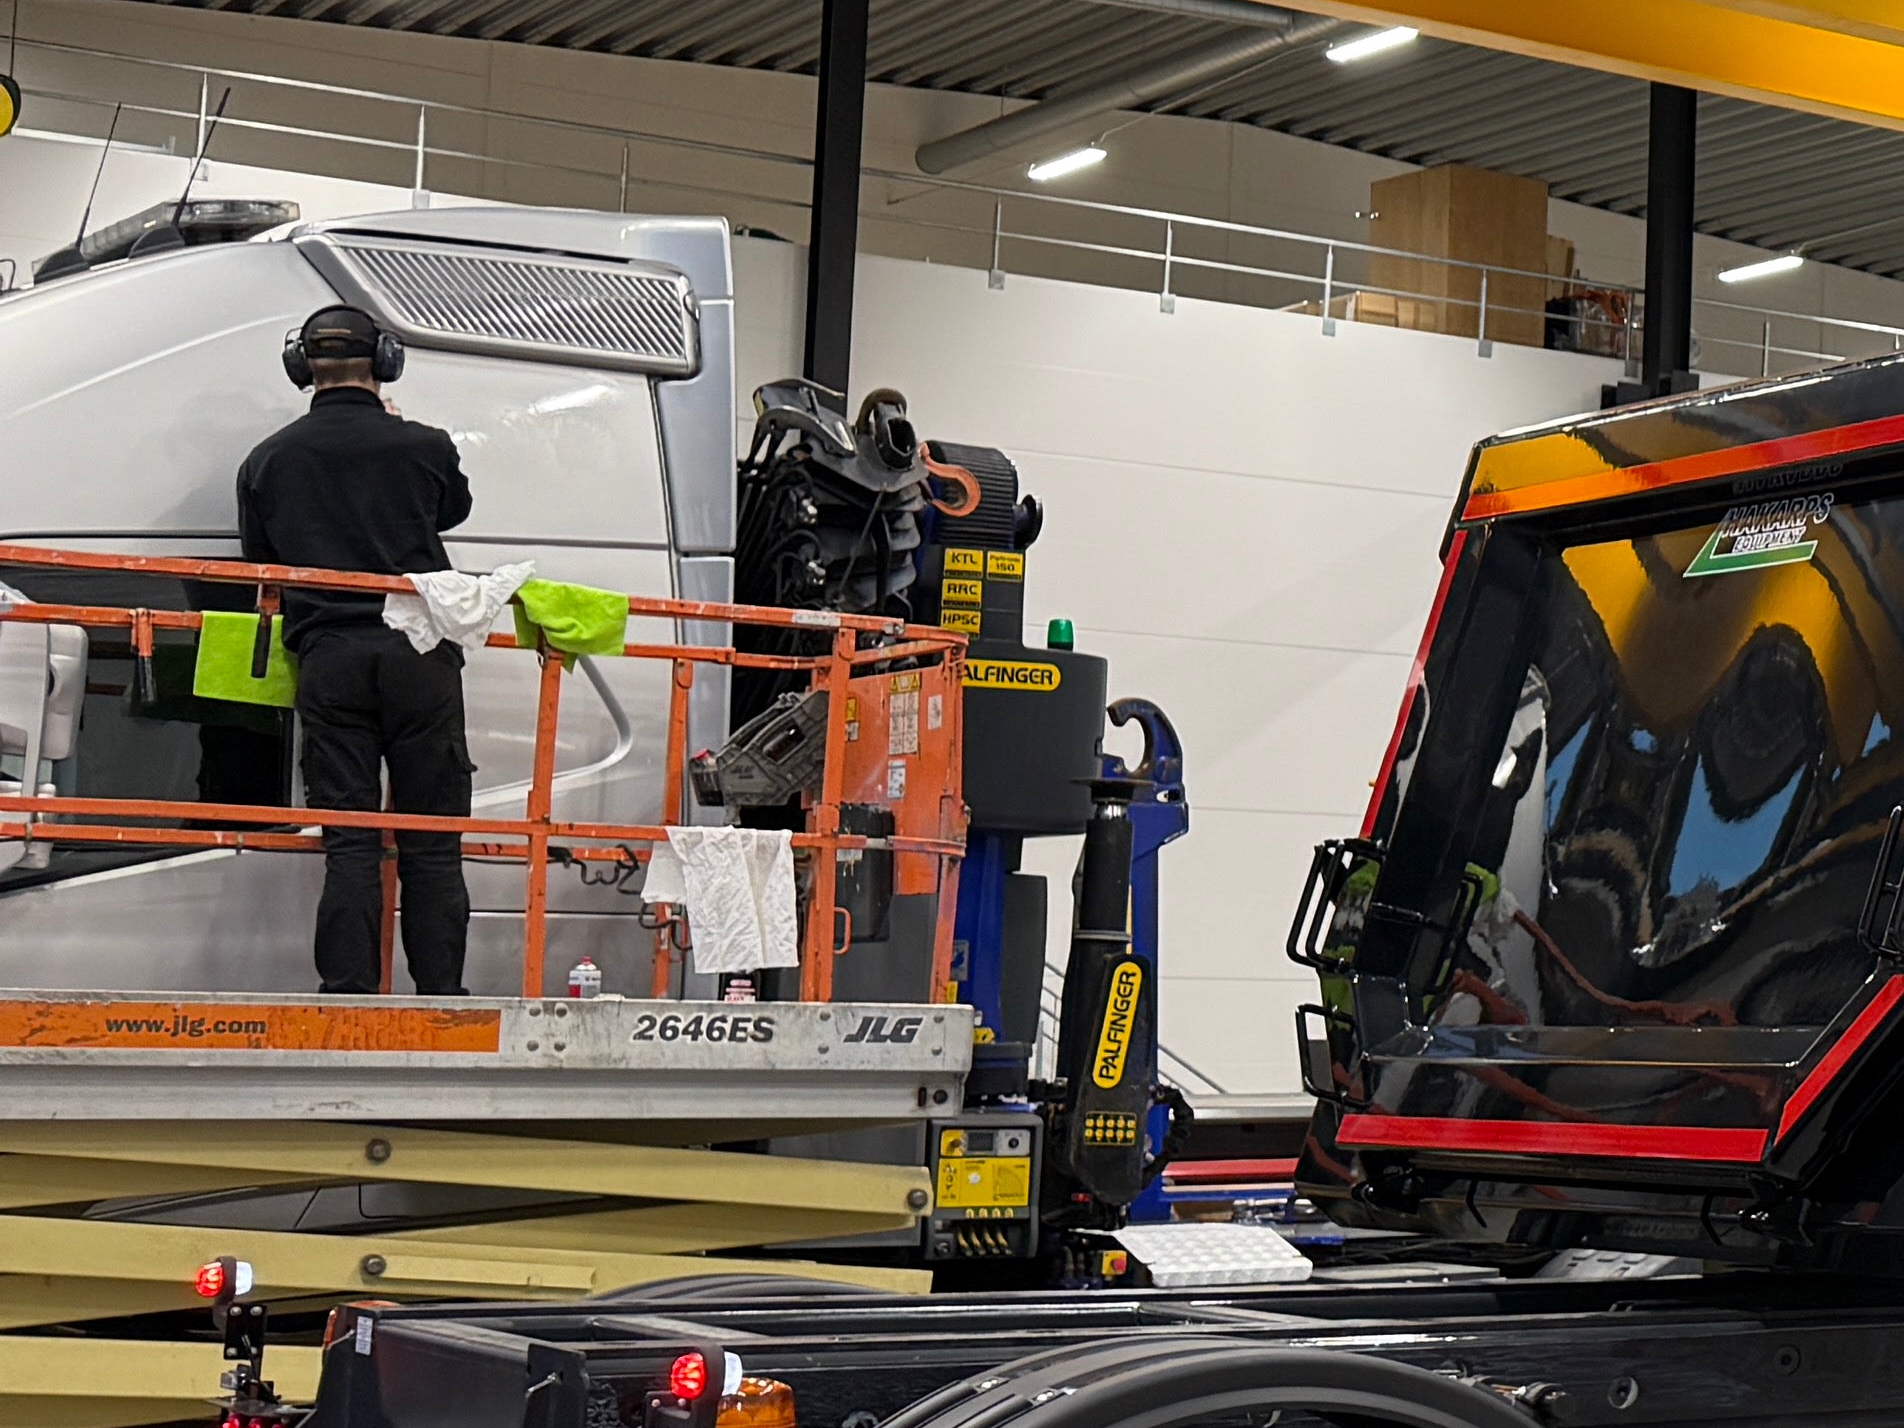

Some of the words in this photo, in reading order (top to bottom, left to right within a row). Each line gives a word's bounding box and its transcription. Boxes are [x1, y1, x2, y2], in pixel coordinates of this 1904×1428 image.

[1722, 492, 1834, 538] HAKARPS
[951, 552, 978, 565] KTL
[943, 611, 979, 626] HPSC
[964, 664, 1053, 686] ALFINGER
[105, 1007, 267, 1038] www.jlg.com
[632, 1014, 775, 1043] 2646ES
[843, 1016, 923, 1043] JLG
[1098, 970, 1137, 1080] PALFINGER
